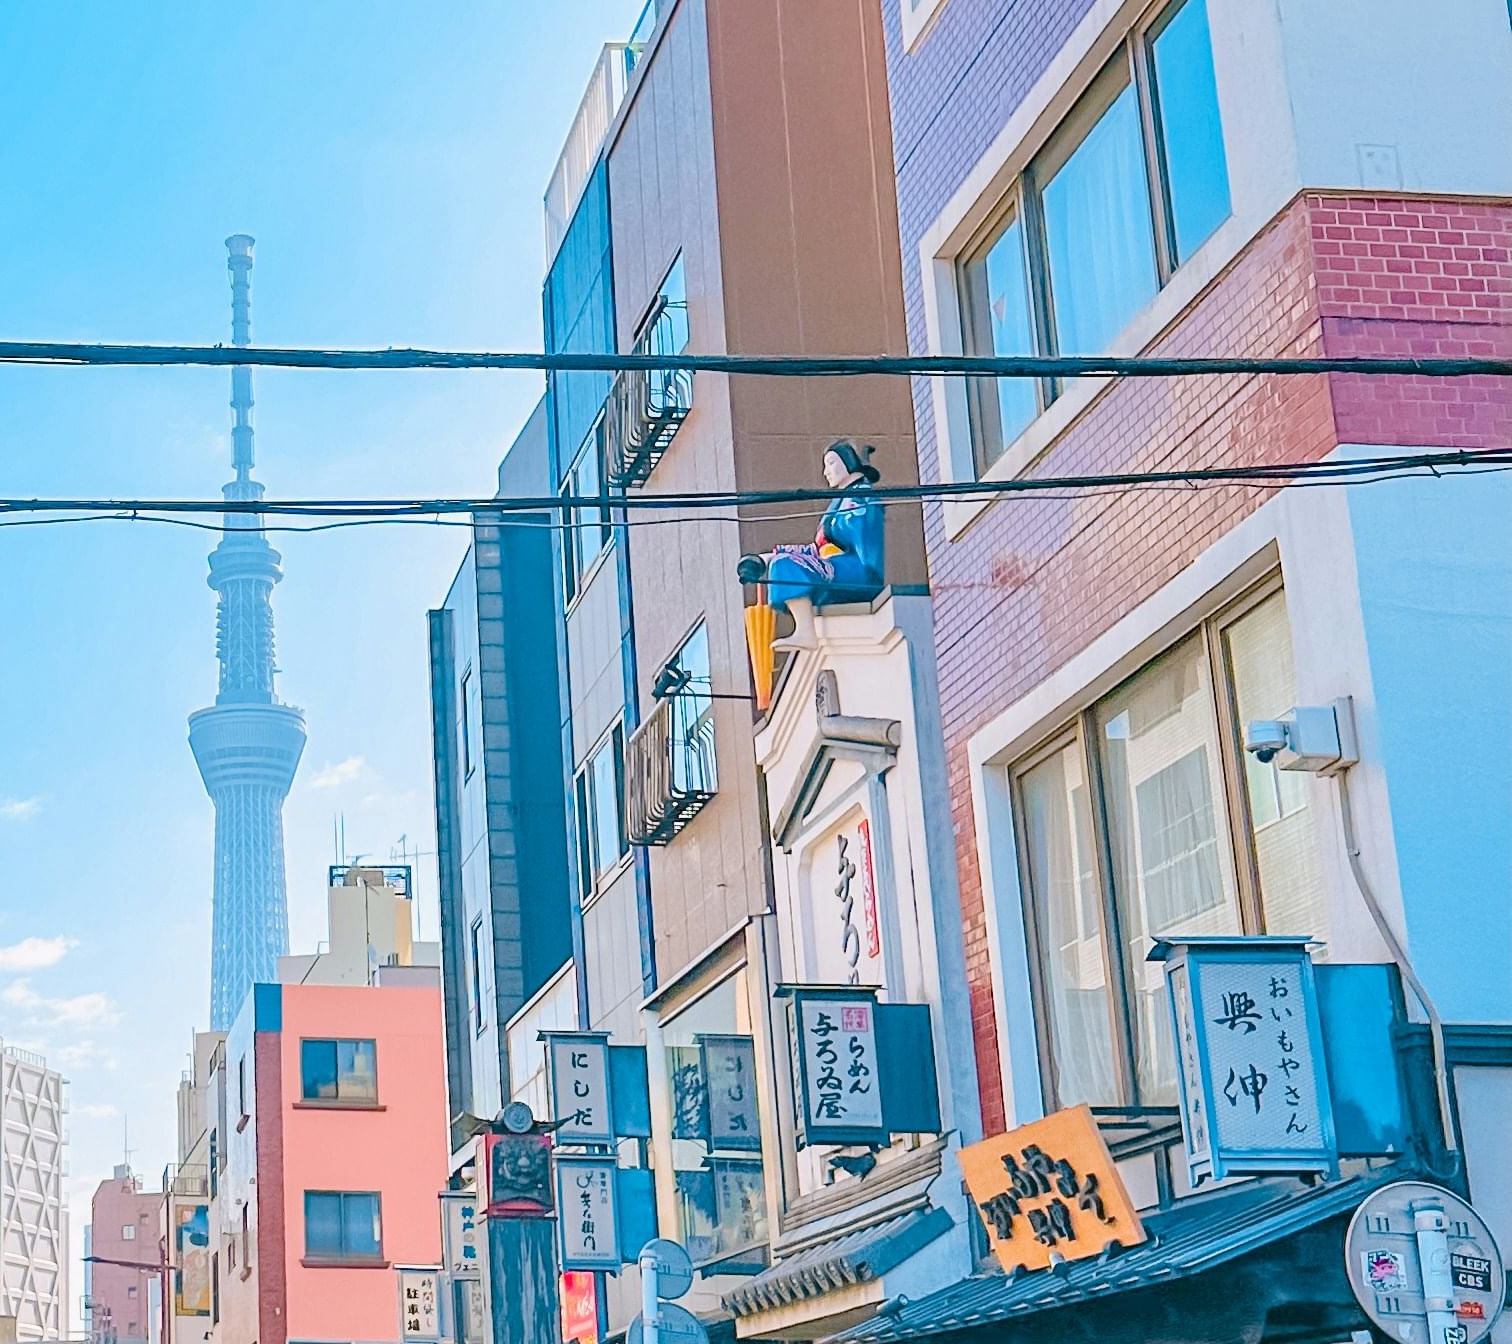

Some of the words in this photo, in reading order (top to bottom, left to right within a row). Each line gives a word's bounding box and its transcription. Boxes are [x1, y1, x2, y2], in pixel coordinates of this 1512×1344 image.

[571, 1051, 593, 1126] にしだ
[1268, 977, 1307, 1134] おいもやさん
[406, 1287, 420, 1332] 駐車場
